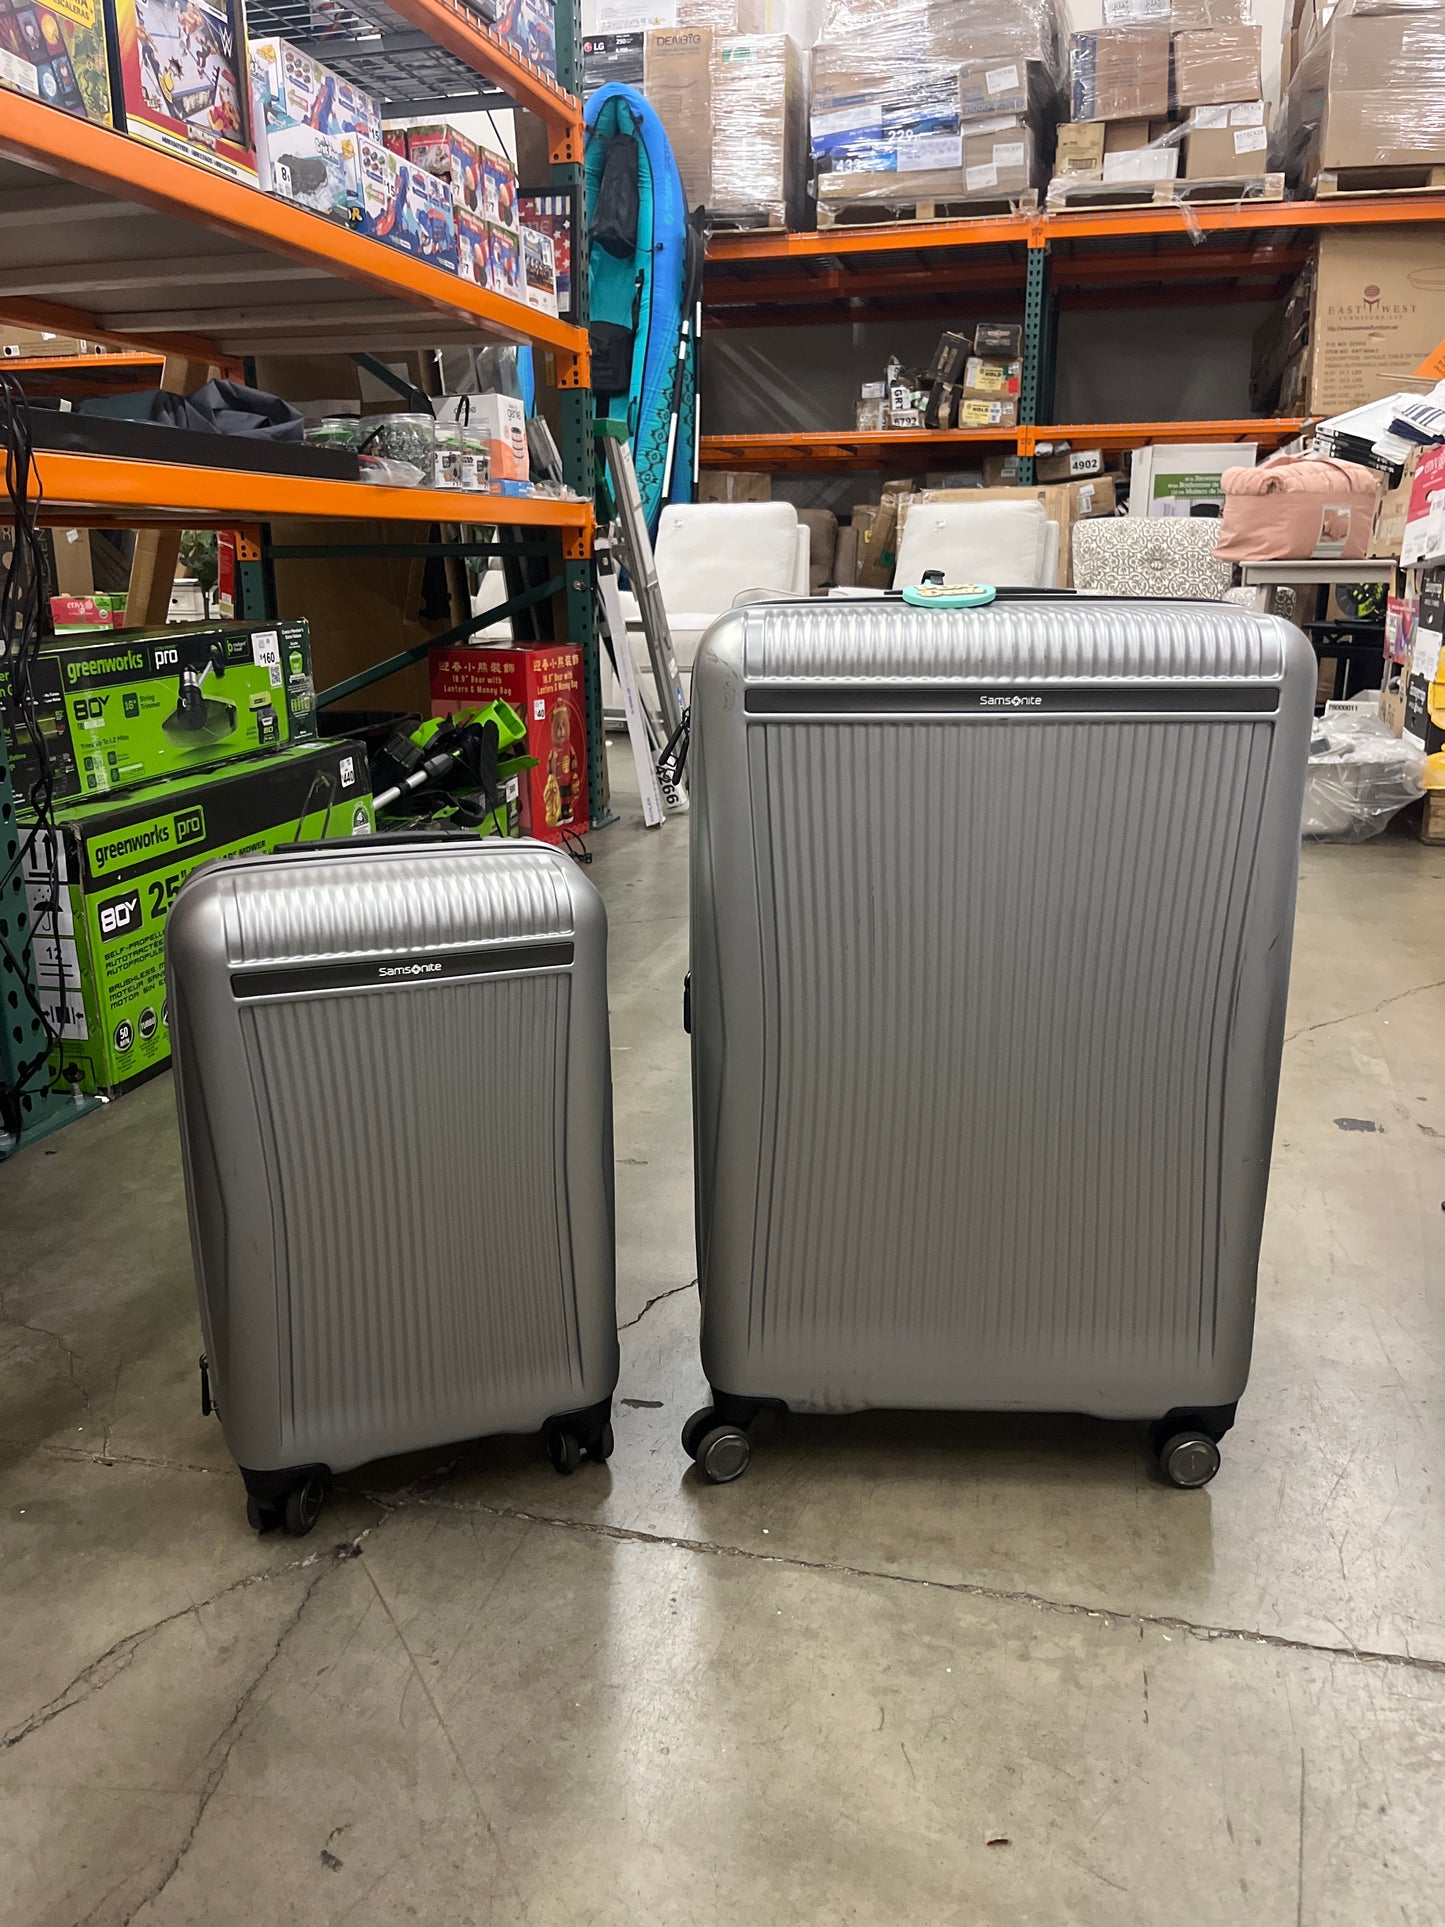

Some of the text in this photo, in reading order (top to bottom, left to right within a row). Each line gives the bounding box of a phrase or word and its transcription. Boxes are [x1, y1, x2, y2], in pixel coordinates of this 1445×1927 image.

[593, 43, 605, 51] LG
[1328, 304, 1417, 315] EAST WEST
[1072, 458, 1098, 471] 4902
[155, 649, 179, 670] pro
[67, 650, 144, 685] greenworks
[487, 676, 502, 684] with
[443, 685, 469, 693] Lantern
[476, 685, 498, 696] Money
[499, 686, 512, 697] Bag
[979, 695, 1042, 706] Samsonite
[95, 816, 200, 869] greenworks pro
[239, 840, 266, 856] MOWER
[101, 898, 138, 934] 80V
[378, 963, 442, 977] Samsonite
[108, 966, 156, 994] BRUSHLESS
[109, 981, 144, 1002] MOTEUR
[110, 991, 140, 1011] MOTOR
[119, 1026, 129, 1040] 50
